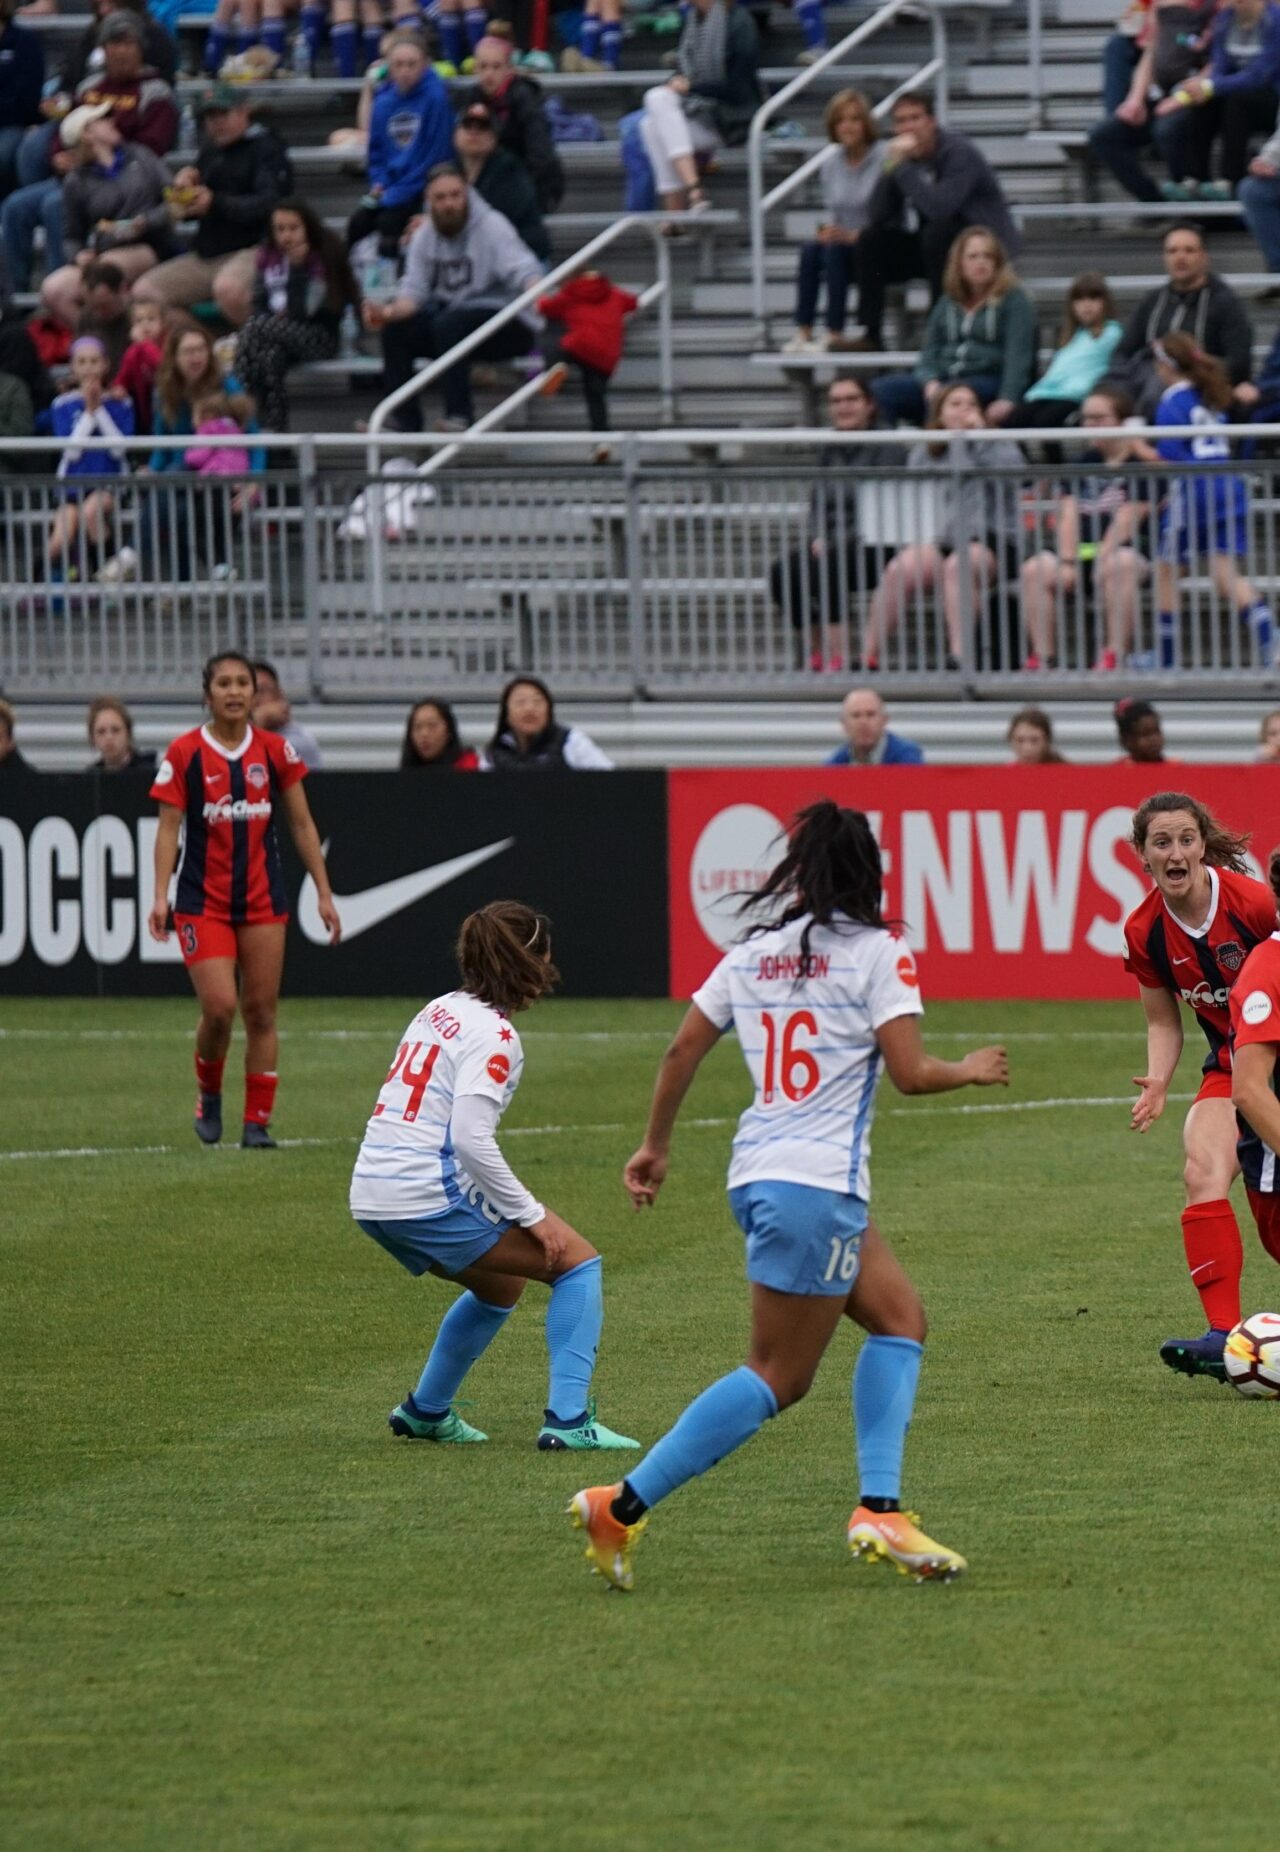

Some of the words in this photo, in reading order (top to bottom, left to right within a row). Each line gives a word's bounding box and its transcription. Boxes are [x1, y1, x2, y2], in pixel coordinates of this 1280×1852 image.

[182, 923, 198, 954] 3
[761, 1010, 820, 1104] 16
[824, 1236, 861, 1282] 16
